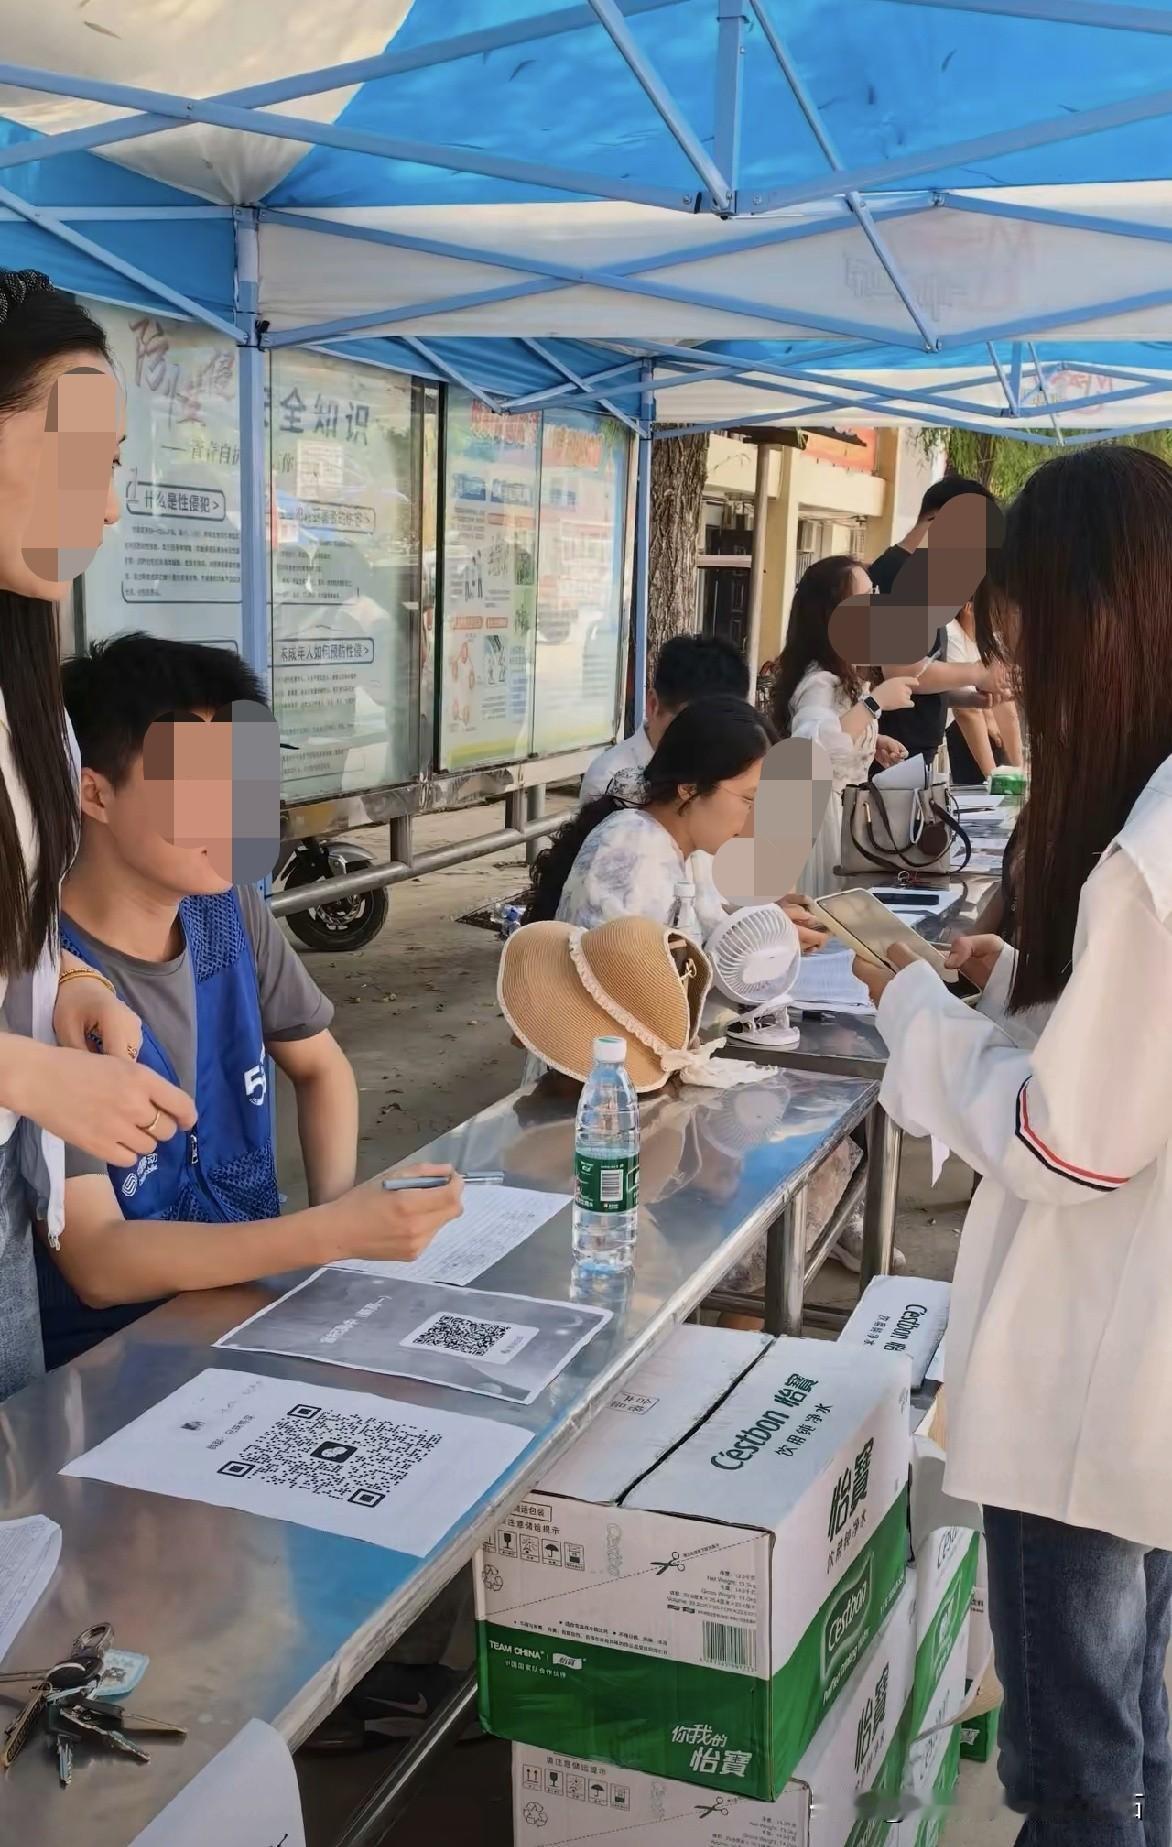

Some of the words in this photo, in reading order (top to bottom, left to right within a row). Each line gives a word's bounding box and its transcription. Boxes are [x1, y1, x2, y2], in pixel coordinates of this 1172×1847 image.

[489, 1639, 513, 1654] TEAM
[671, 1724, 728, 1748] 你我的
